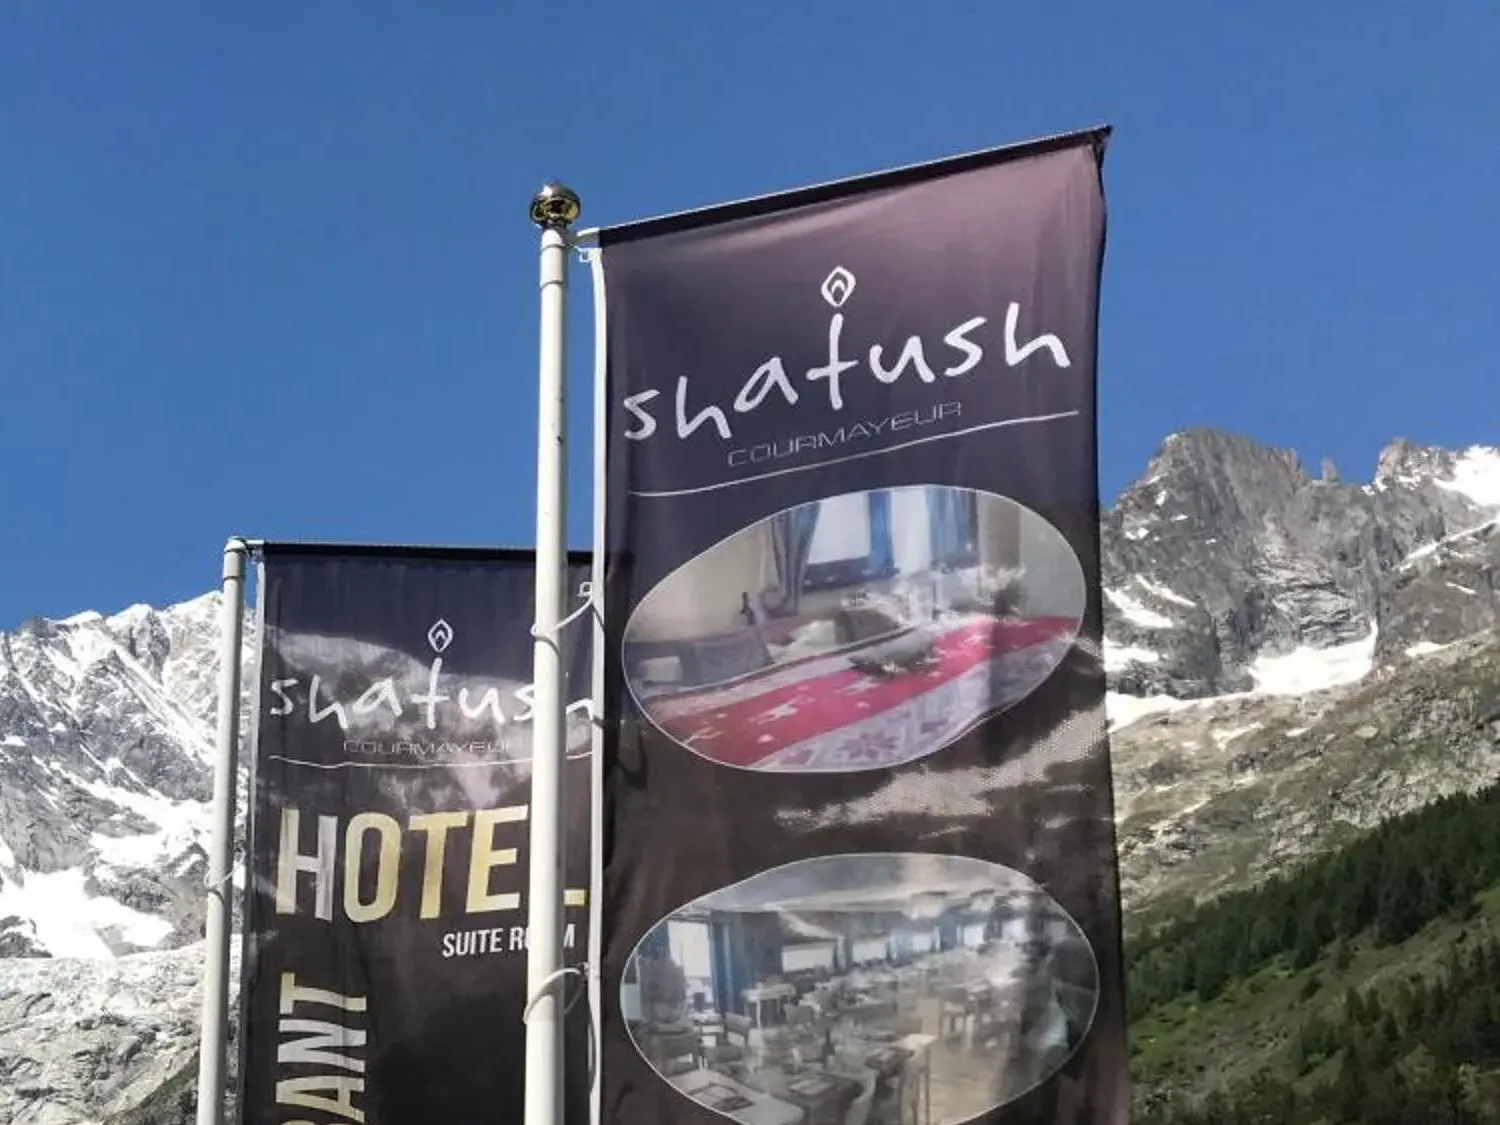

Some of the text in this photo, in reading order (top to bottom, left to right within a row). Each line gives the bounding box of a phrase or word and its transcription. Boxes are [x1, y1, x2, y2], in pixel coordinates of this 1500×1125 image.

[622, 300, 1071, 442] shatush
[726, 400, 962, 468] COURMAYEUR
[275, 806, 590, 924] HOTE
[441, 923, 577, 958] SUITE RM
